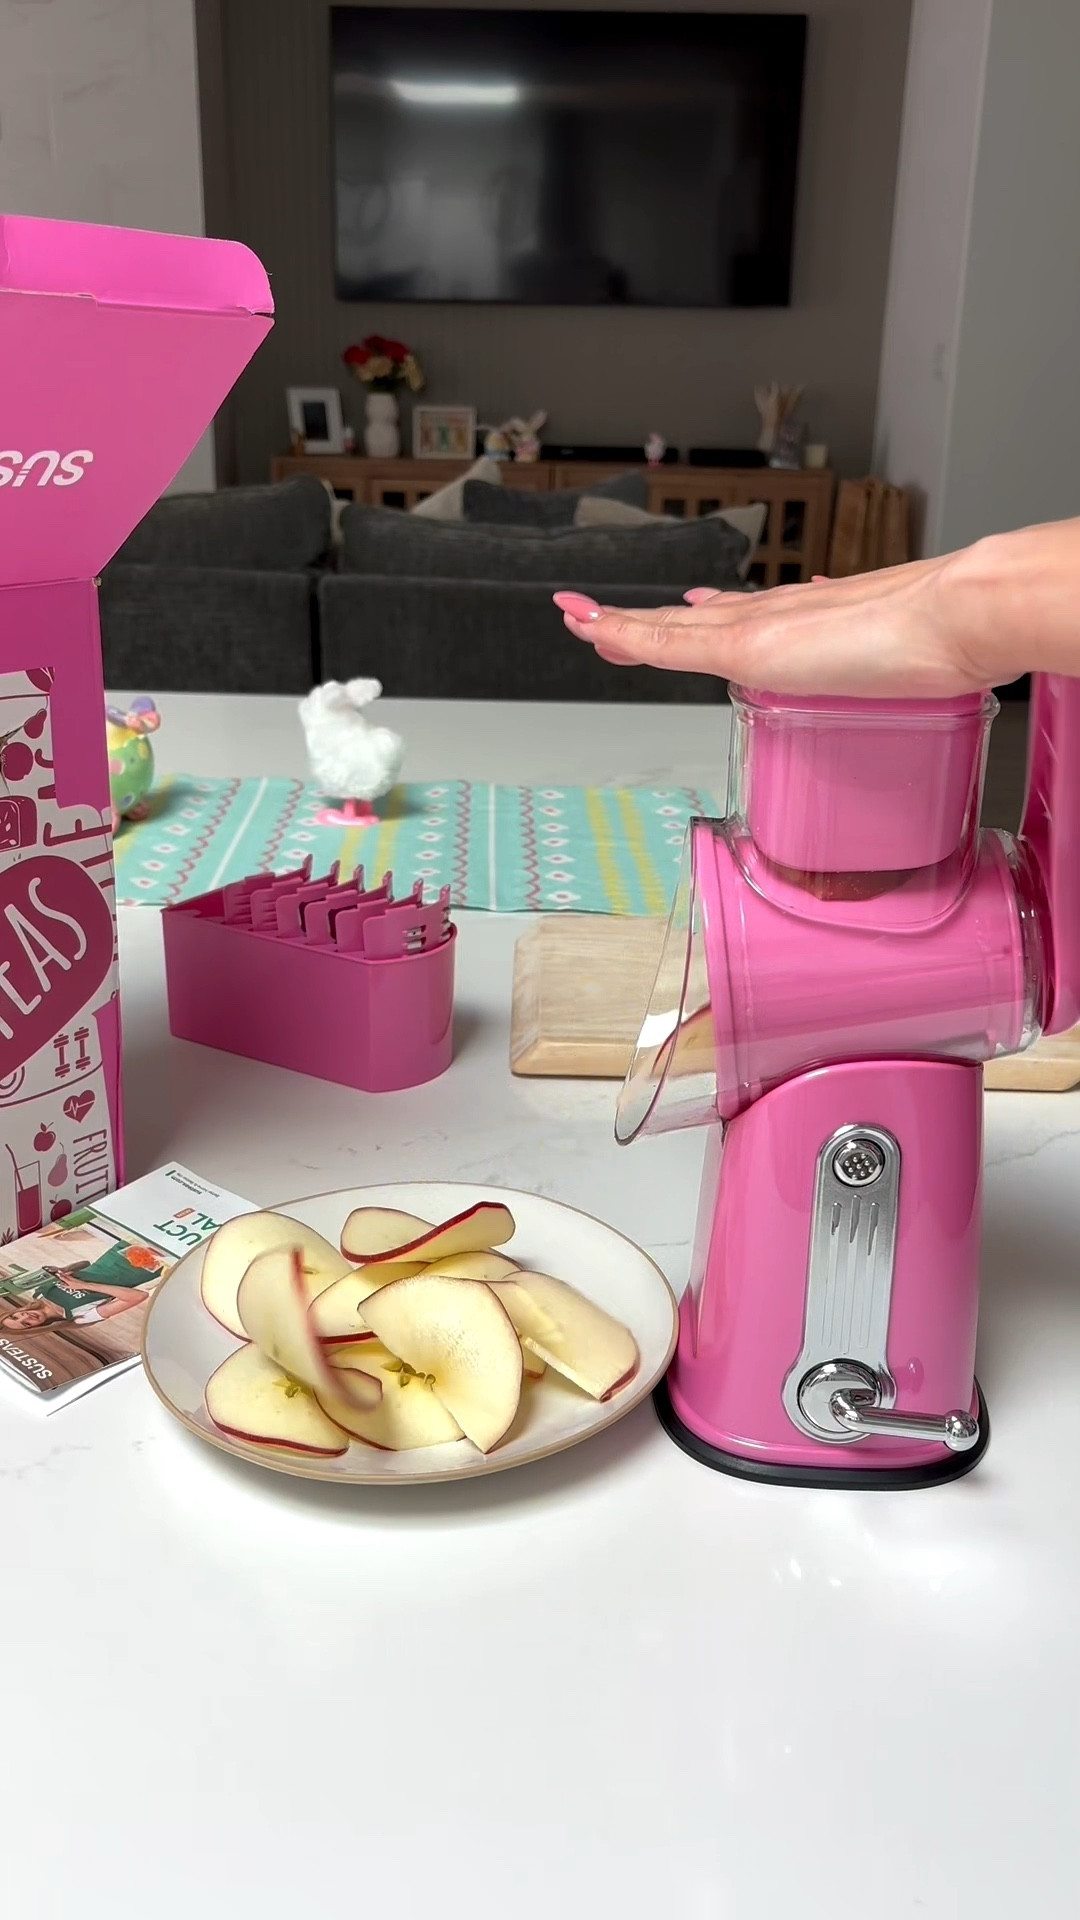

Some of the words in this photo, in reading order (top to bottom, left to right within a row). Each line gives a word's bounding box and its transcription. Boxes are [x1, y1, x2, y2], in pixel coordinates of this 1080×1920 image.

[0, 877, 87, 1040] EAS
[73, 1128, 109, 1205] FRUIT
[0, 1338, 53, 1379] SUSTEAS
